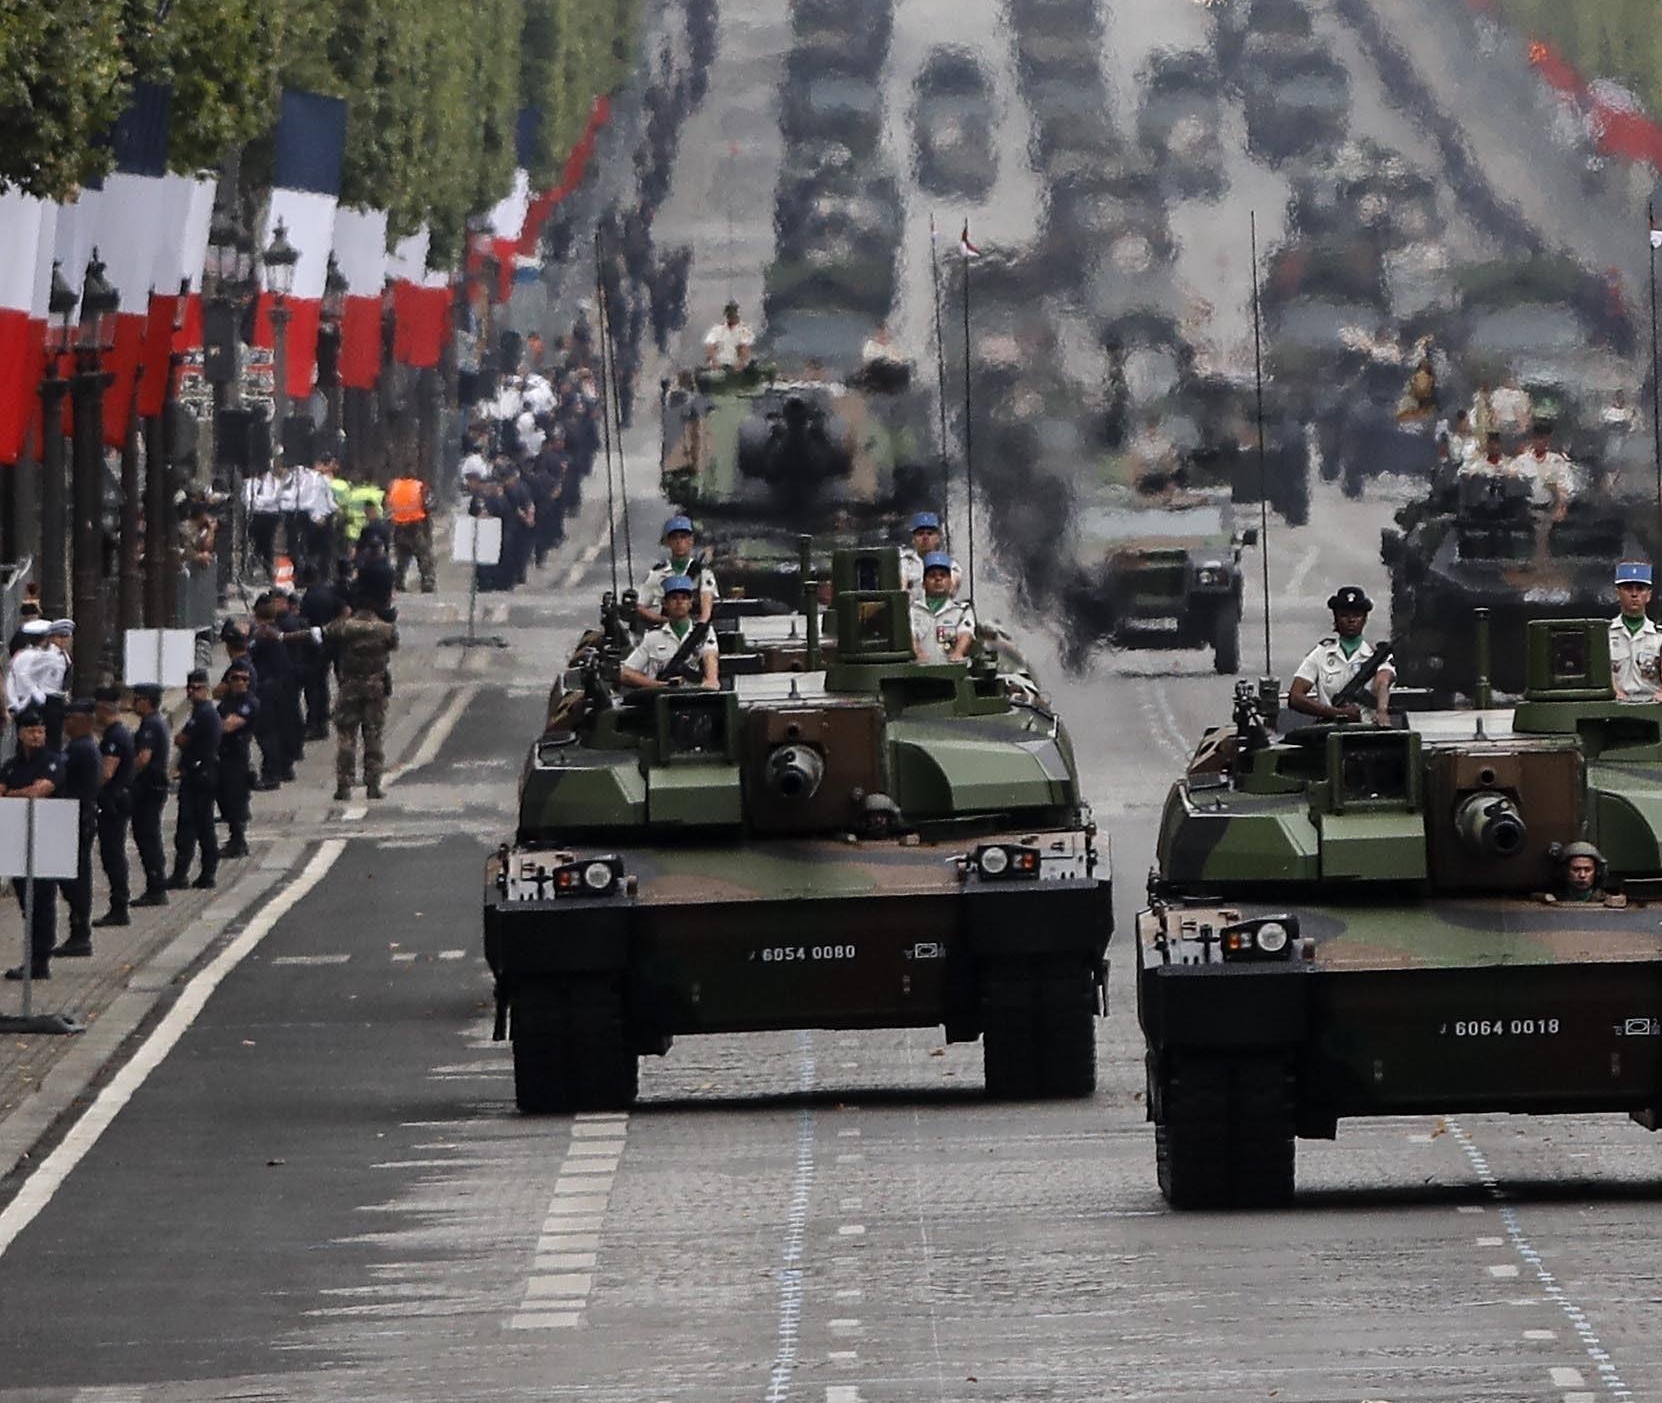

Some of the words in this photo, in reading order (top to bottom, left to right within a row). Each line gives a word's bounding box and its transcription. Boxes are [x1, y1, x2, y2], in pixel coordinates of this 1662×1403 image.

[762, 947, 806, 962] 6054
[812, 944, 856, 960] 0080
[1455, 1020, 1504, 1036] 6064
[1510, 1018, 1560, 1035] 0018
